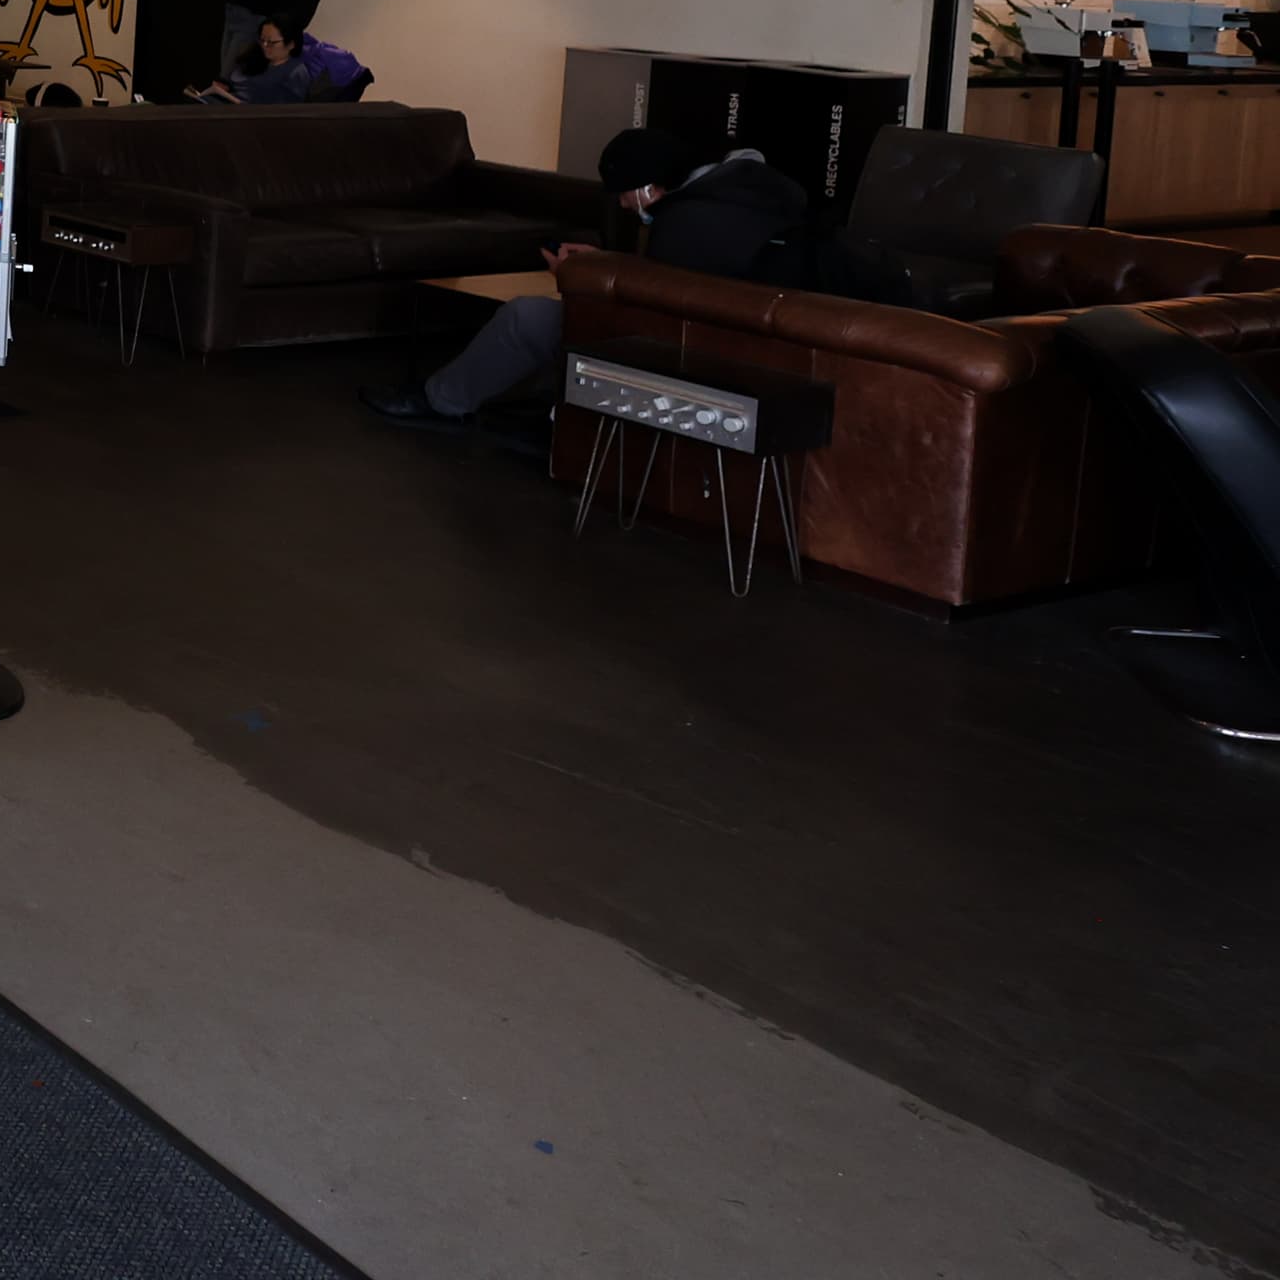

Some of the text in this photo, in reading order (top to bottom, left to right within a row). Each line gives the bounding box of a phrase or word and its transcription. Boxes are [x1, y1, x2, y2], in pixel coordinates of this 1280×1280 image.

[633, 83, 646, 128] OMPOST
[727, 92, 740, 131] TRASH
[827, 104, 844, 187] RECYCLABLES
